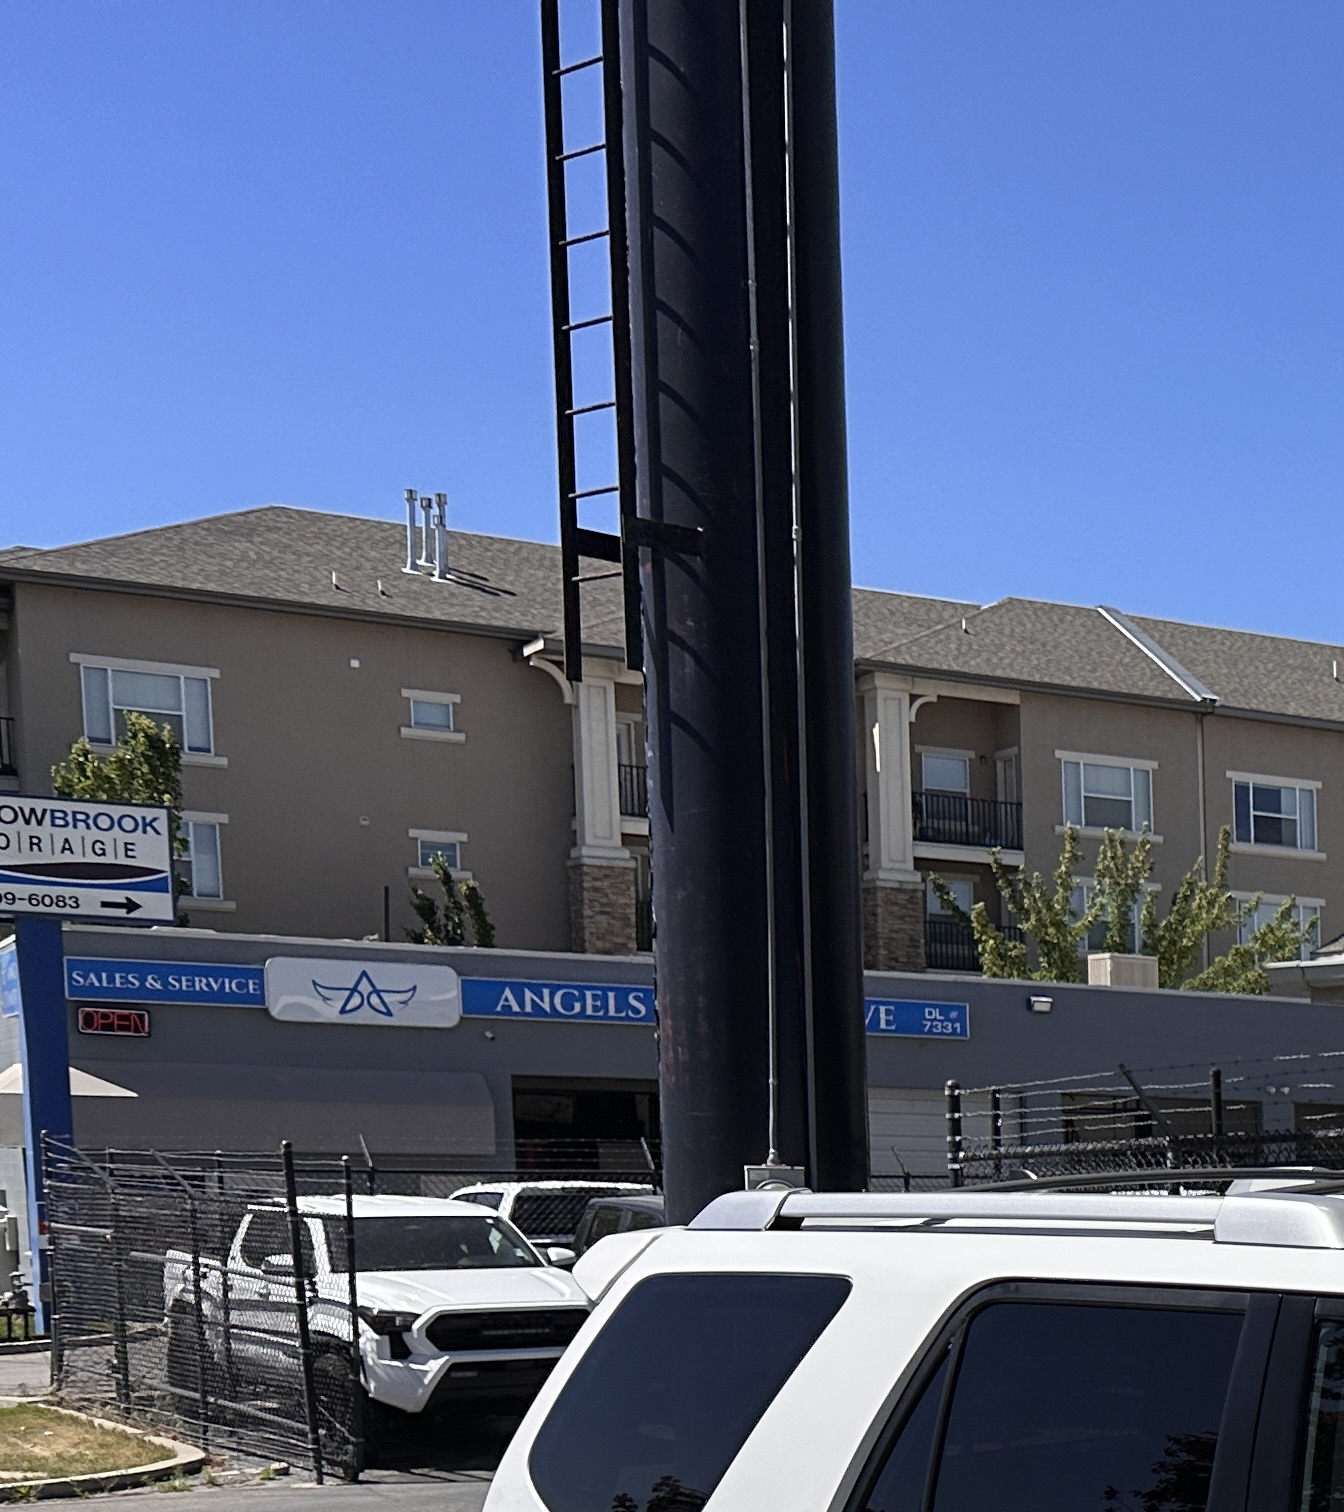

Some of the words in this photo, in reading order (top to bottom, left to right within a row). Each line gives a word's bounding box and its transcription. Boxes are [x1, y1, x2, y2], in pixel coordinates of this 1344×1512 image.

[0, 805, 162, 836] OWBROOK
[0, 891, 80, 910] 9-6083
[71, 970, 140, 989] SALES
[145, 974, 164, 990] &
[168, 975, 261, 994] SERVICE
[495, 986, 647, 1019] ANGELS
[924, 1007, 945, 1020] DL
[80, 1009, 148, 1036] OPEN
[922, 1021, 961, 1034] 7331
